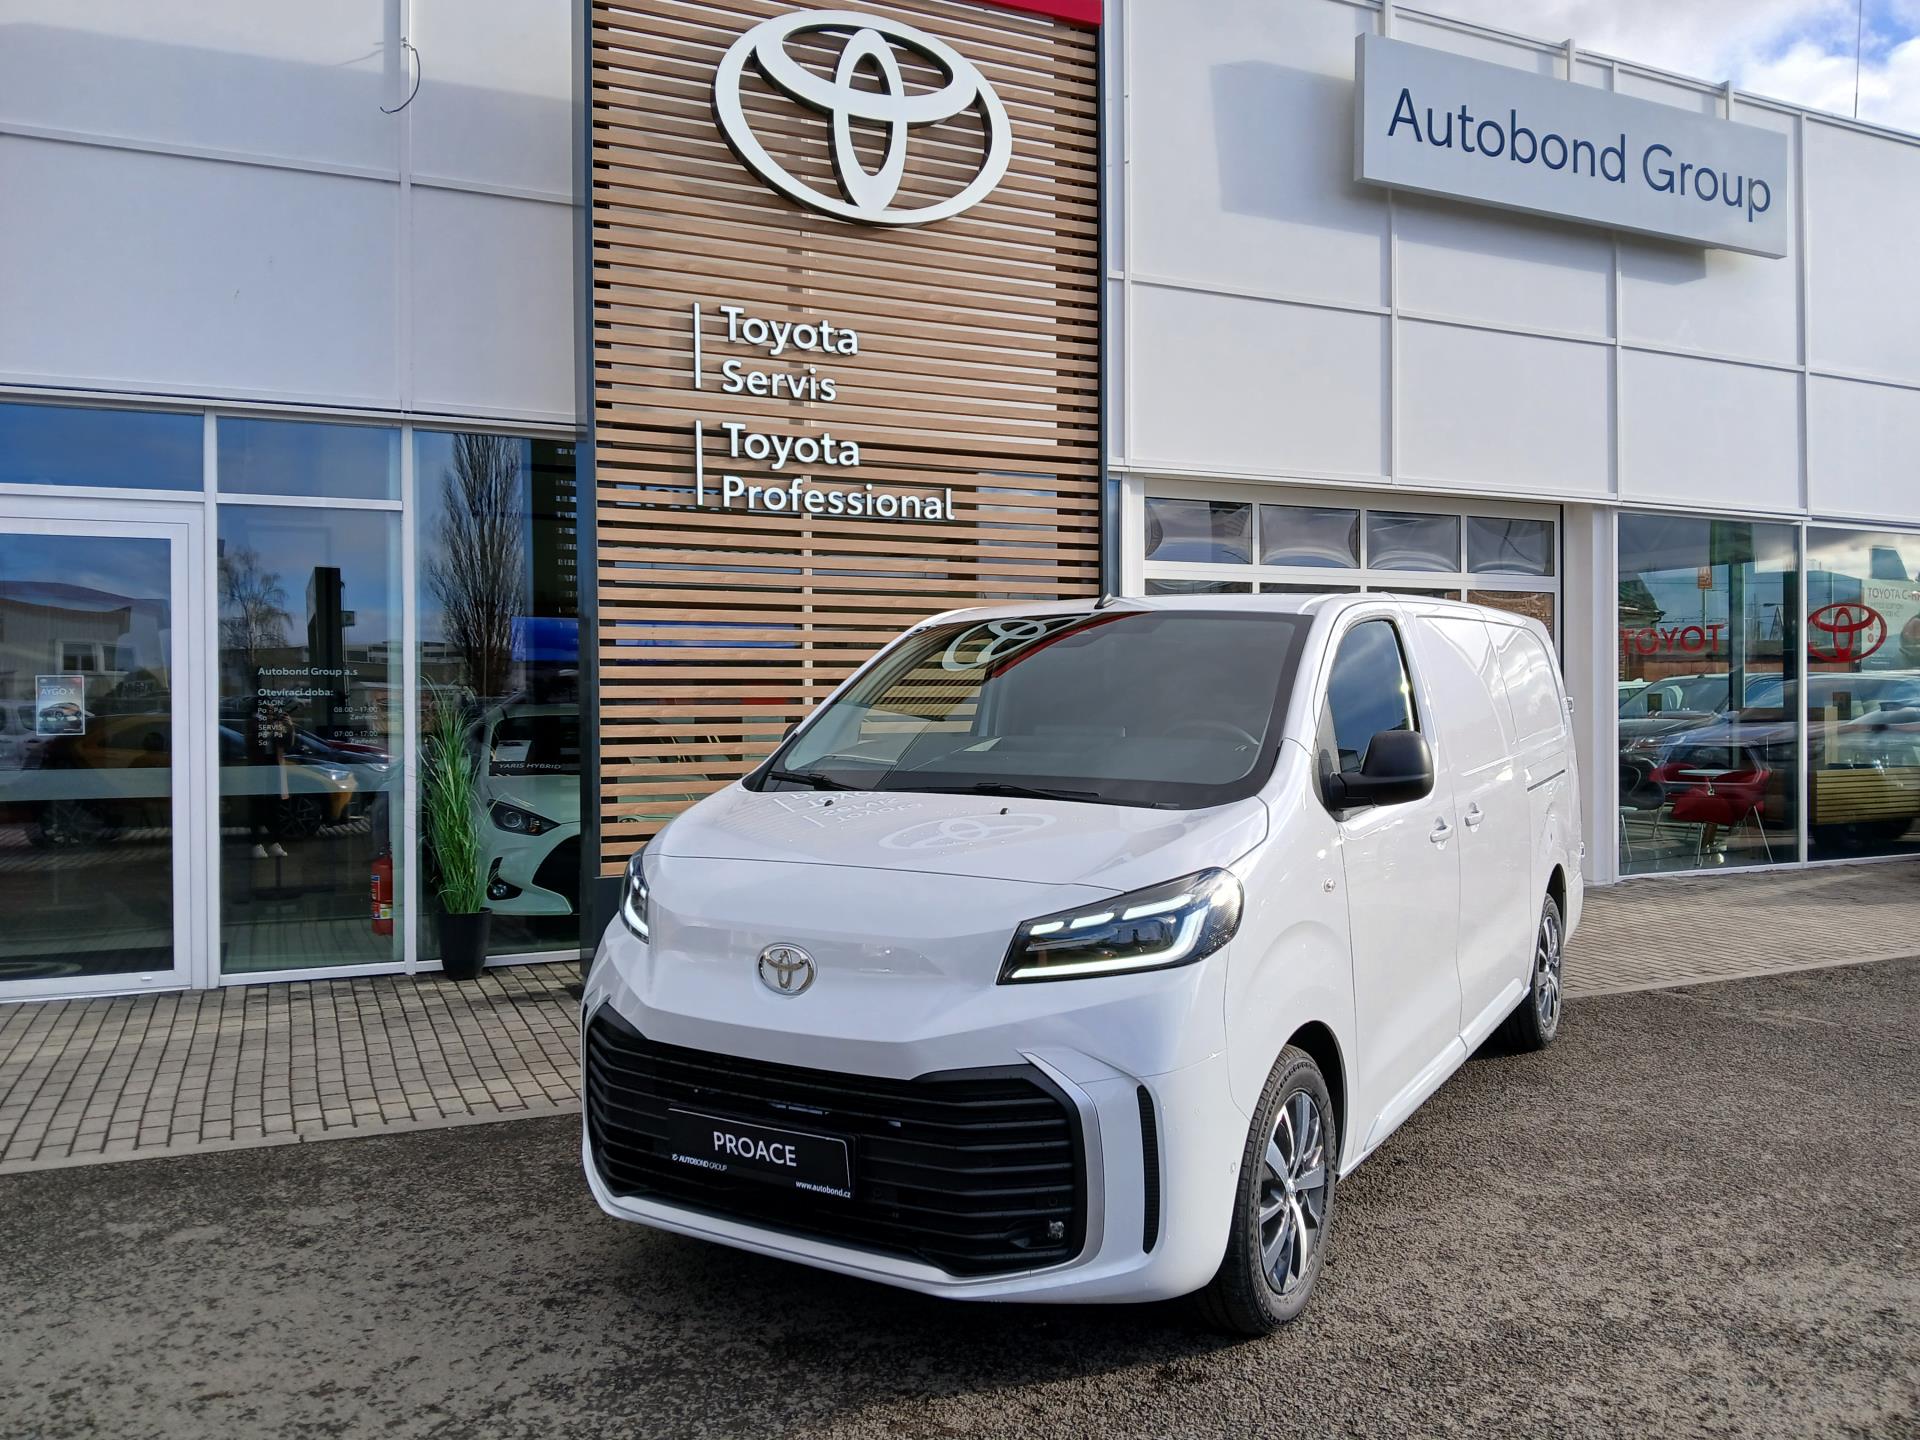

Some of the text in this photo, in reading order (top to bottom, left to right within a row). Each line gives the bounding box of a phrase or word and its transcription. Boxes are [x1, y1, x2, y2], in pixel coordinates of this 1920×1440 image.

[1387, 87, 1772, 222] Autobond Group
[719, 304, 859, 355] Toyota
[721, 359, 837, 402] Servis
[721, 421, 861, 470] Toyota
[722, 475, 956, 520] Professional
[1867, 587, 1901, 601] TOYOTA
[257, 666, 309, 676] Autobond
[310, 667, 343, 678] Group
[41, 687, 67, 697] AYGO
[304, 687, 334, 697] doba:
[526, 762, 562, 770] HYBRID
[713, 1130, 798, 1168] PROACE
[678, 1155, 728, 1172] AUTOBOND GROUP
[795, 1180, 851, 1199] www.autobond.cz
